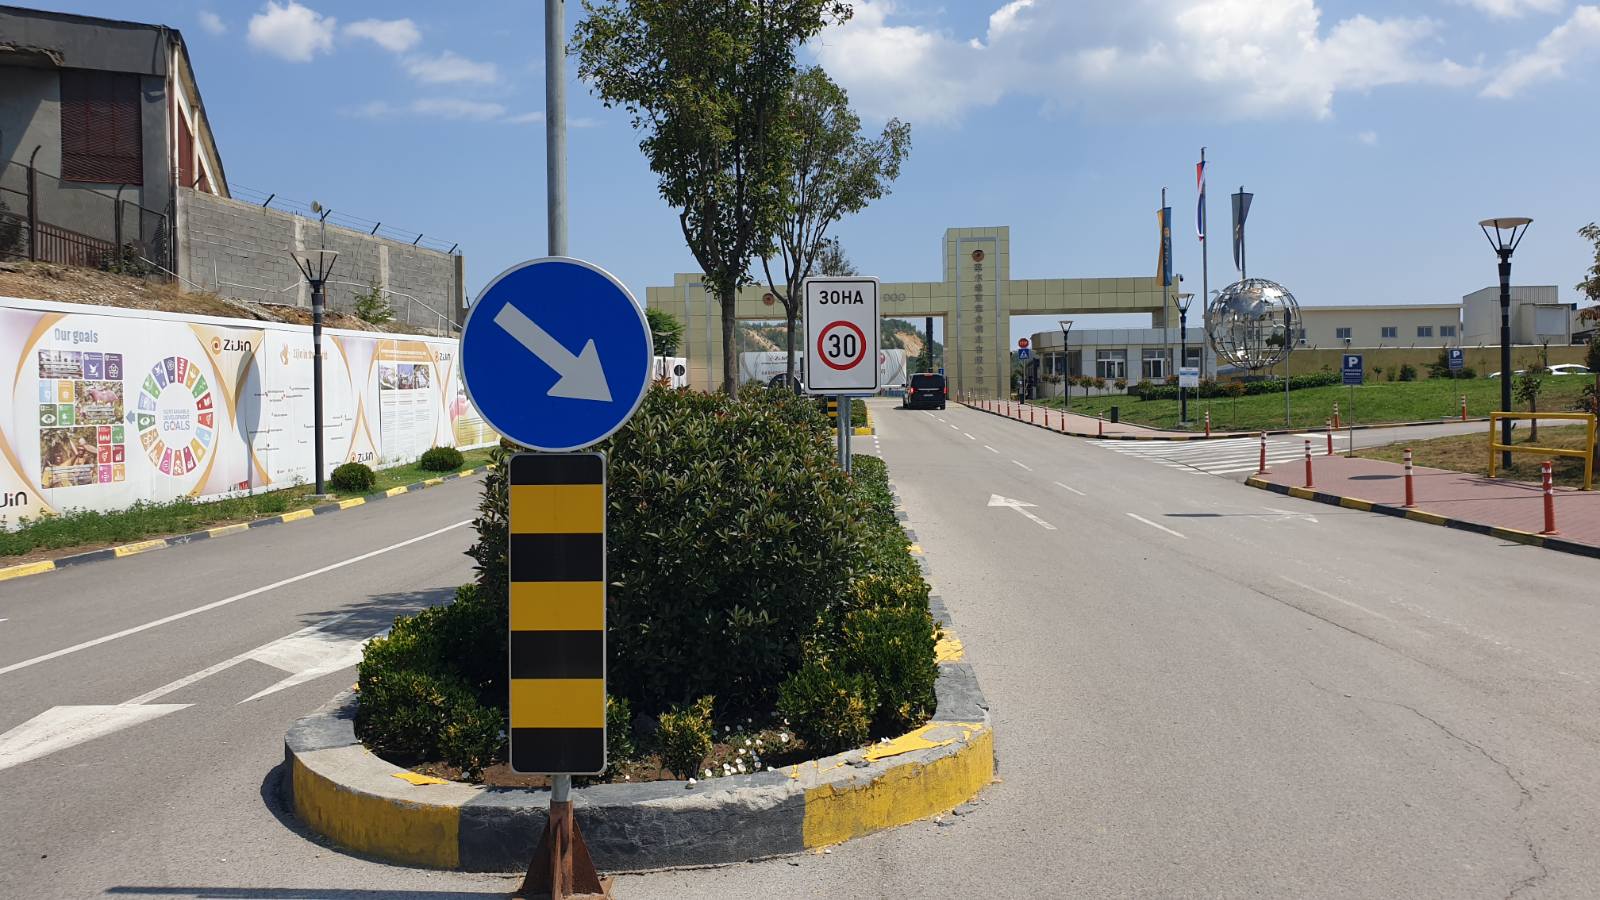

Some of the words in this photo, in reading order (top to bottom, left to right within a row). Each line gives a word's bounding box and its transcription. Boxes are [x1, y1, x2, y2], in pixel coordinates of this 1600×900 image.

[819, 290, 864, 305] ЗОНА
[55, 328, 71, 341] Our
[73, 330, 98, 345] goals
[828, 334, 857, 358] 30
[1452, 350, 1461, 358] P
[1348, 356, 1359, 368] P
[163, 420, 191, 431] GOALS
